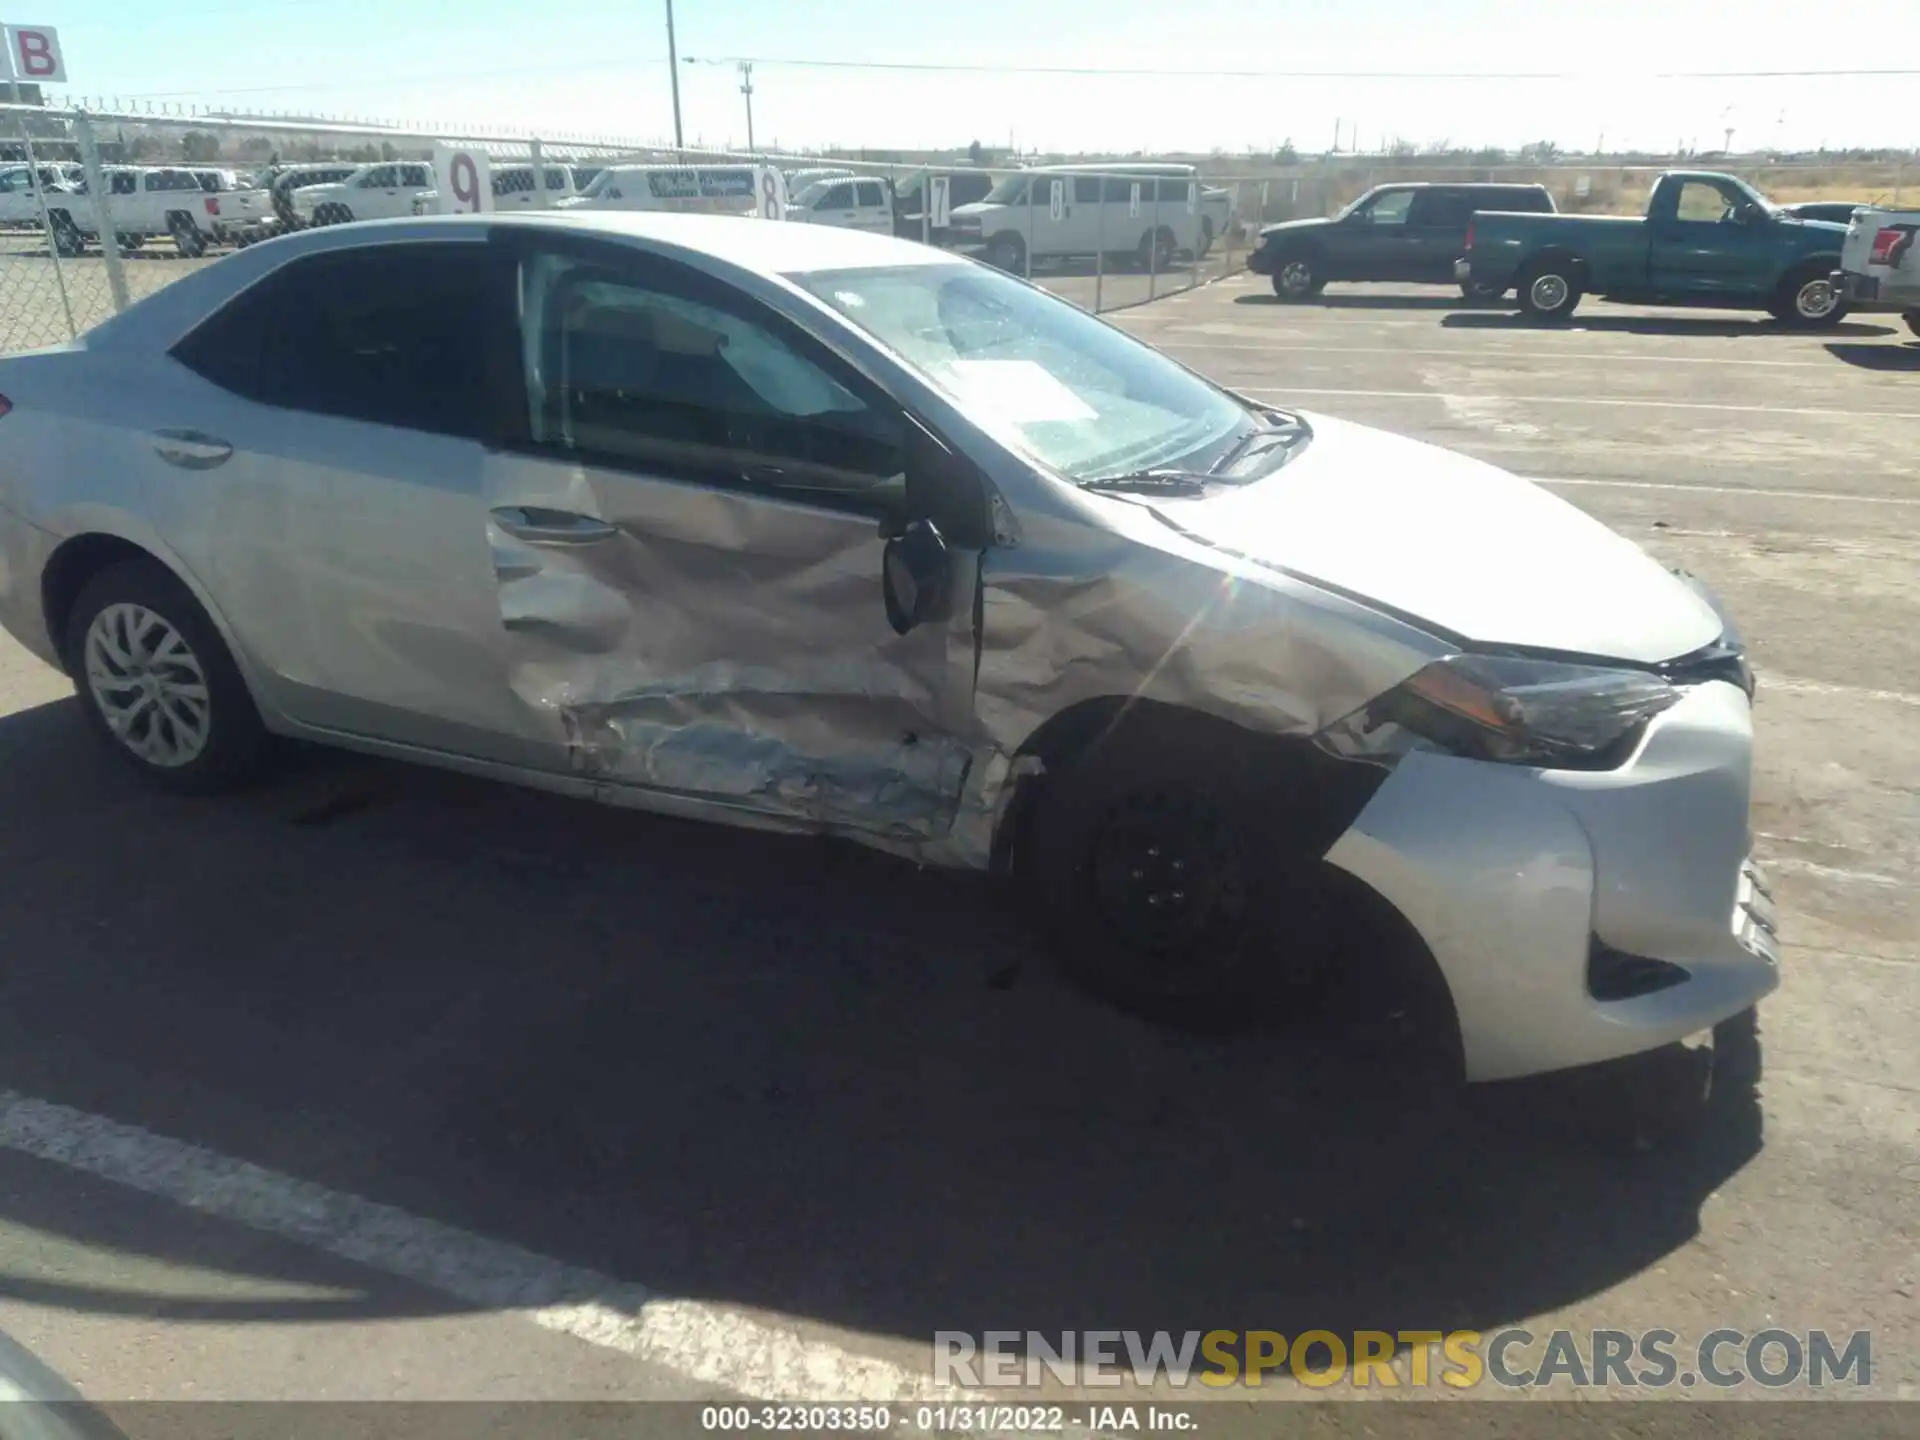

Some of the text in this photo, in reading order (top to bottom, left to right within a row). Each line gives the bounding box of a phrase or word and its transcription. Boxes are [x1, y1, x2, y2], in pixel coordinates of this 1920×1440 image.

[17, 30, 56, 75] B
[450, 151, 480, 213] 9
[762, 172, 780, 220] 8
[934, 178, 946, 226] 7
